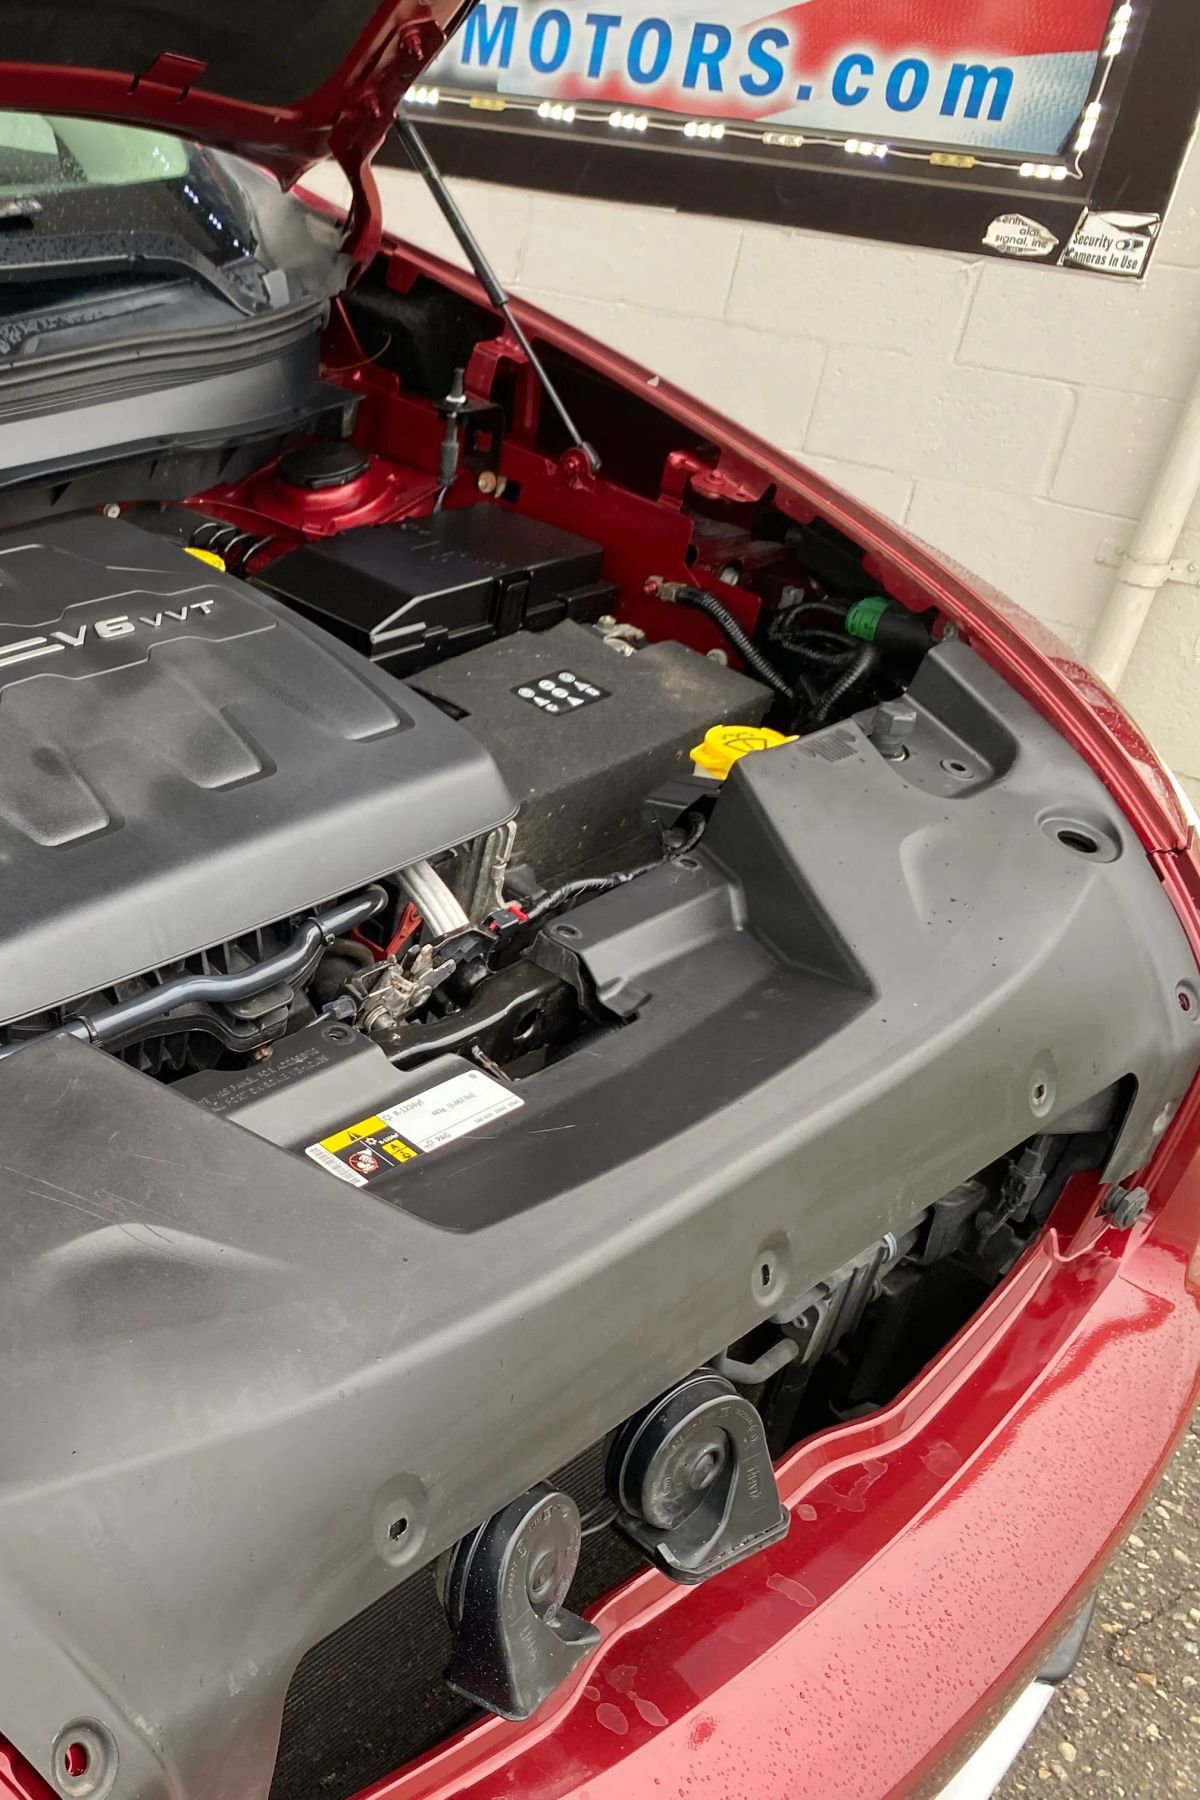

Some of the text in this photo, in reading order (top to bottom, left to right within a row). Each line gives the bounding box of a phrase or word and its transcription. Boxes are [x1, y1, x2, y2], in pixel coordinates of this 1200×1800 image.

[1073, 233, 1114, 252] Security
[1108, 253, 1120, 268] In
[1120, 255, 1139, 270] Use
[50, 600, 214, 646] V6 VVT
